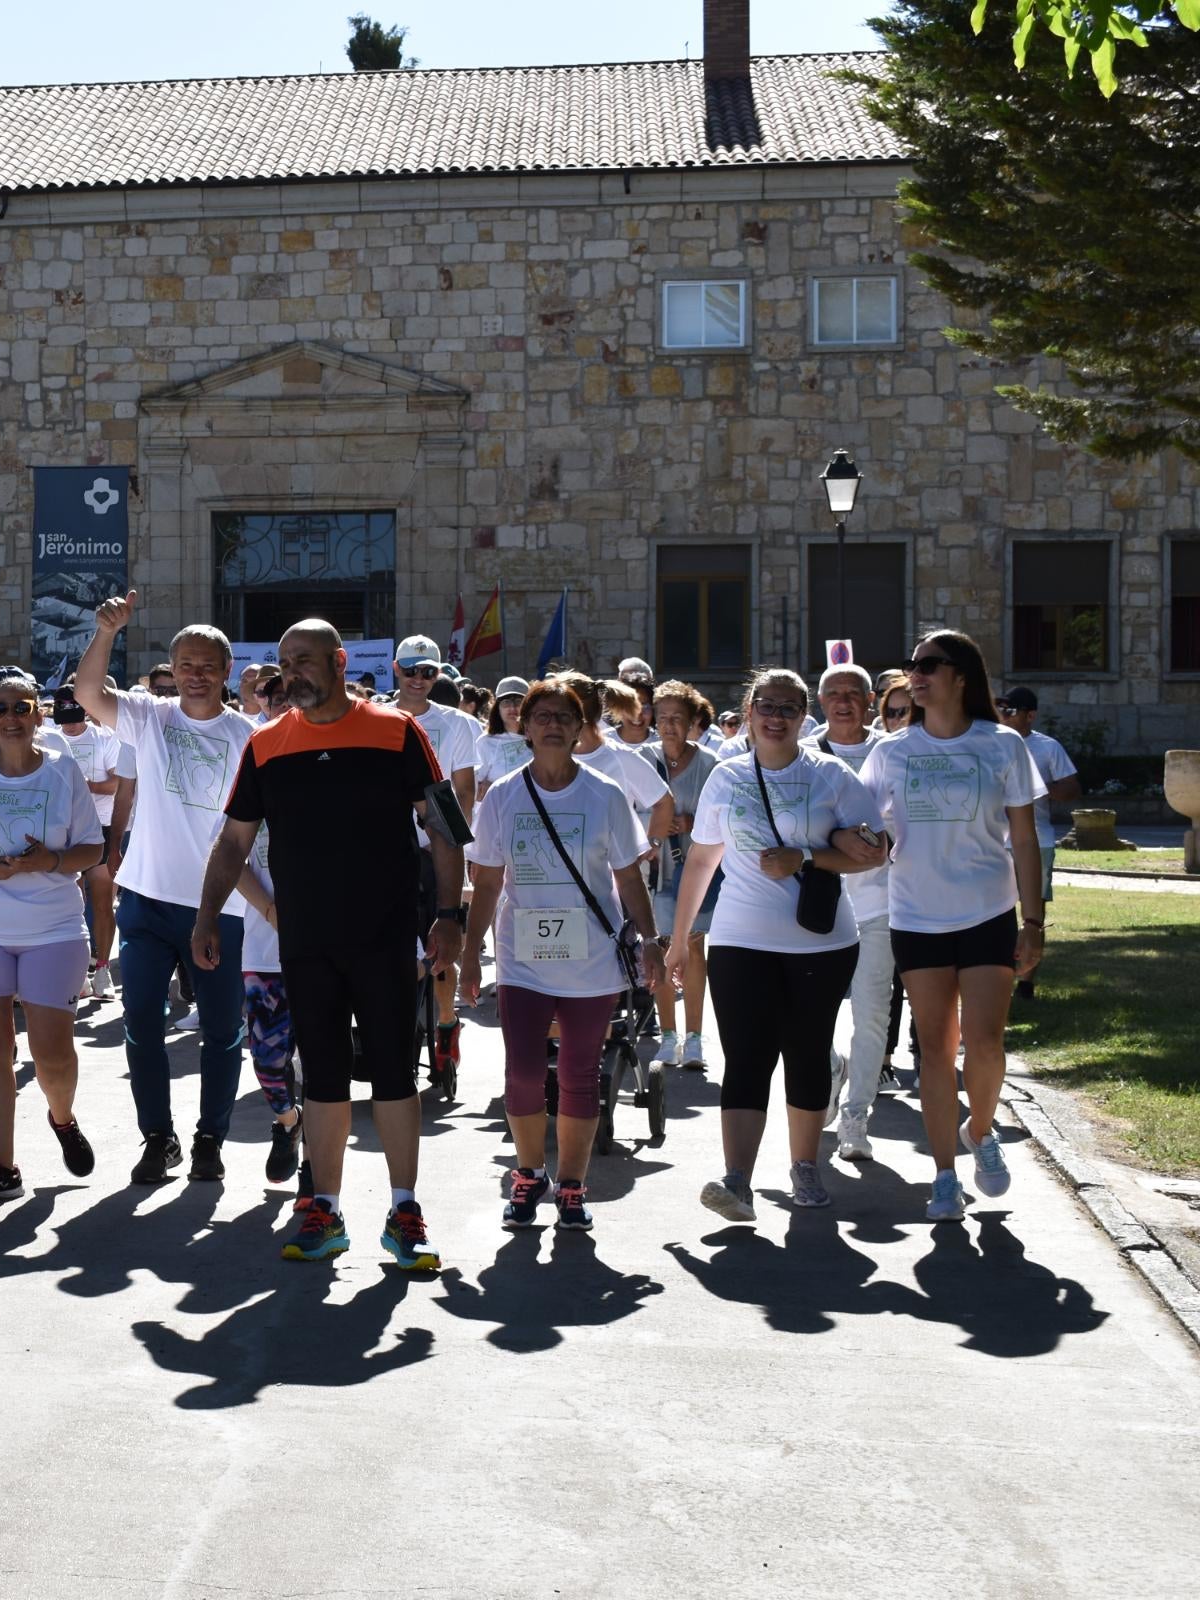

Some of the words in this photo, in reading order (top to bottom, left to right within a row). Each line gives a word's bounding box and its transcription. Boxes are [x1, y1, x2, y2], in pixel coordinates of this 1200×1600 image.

[38, 533, 123, 559] Jerónimo
[47, 533, 67, 542] san
[538, 919, 564, 938] 57
